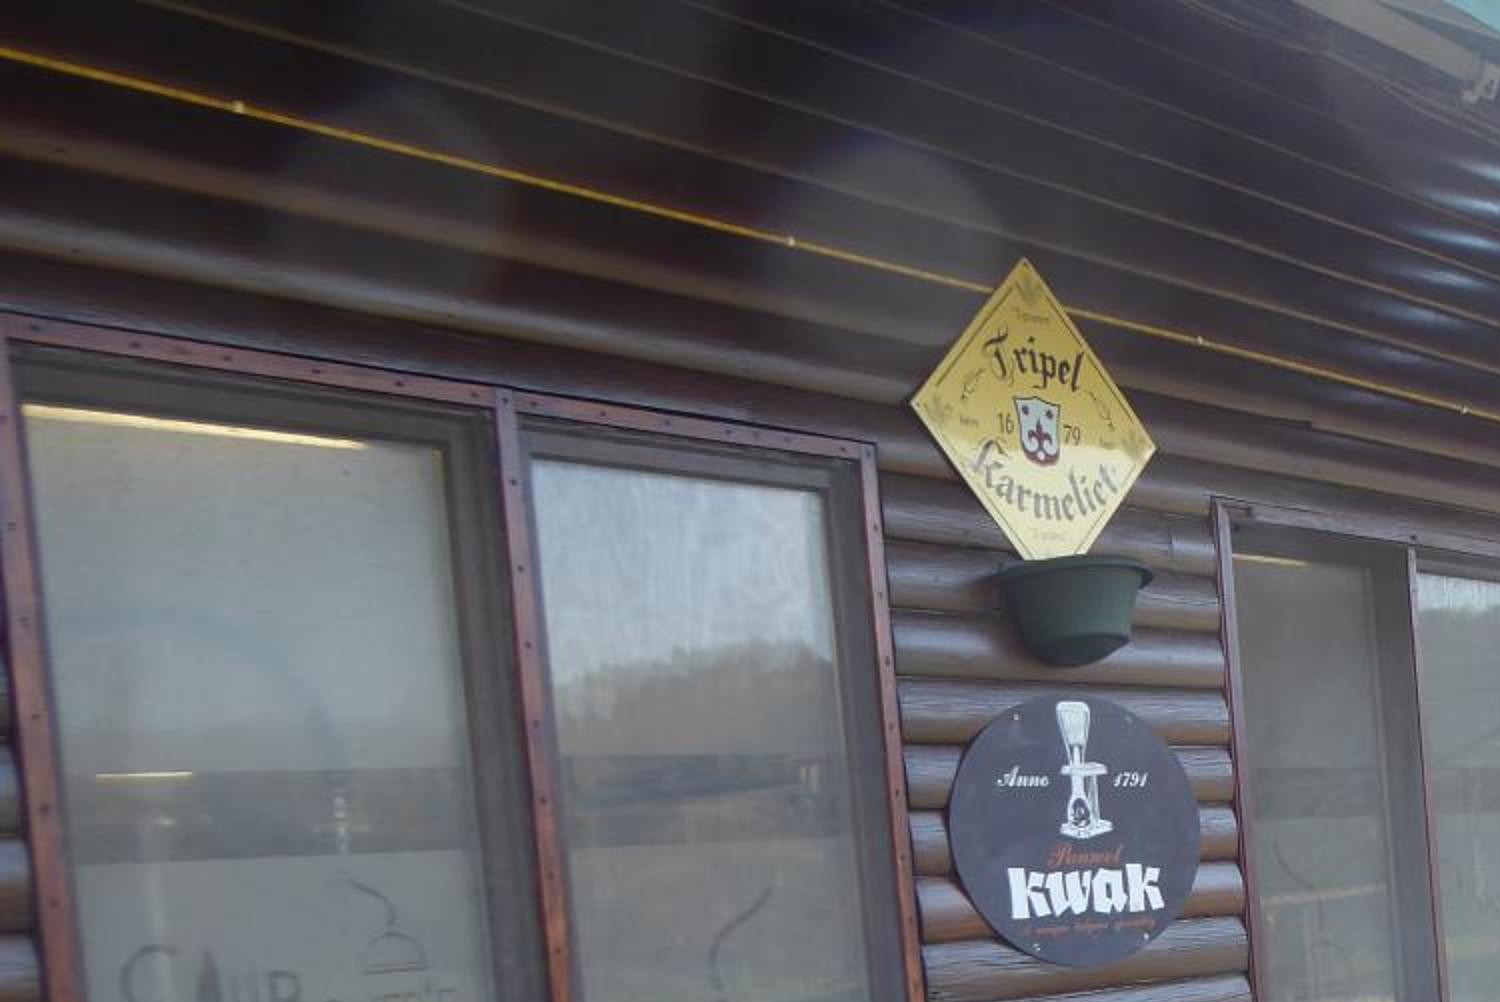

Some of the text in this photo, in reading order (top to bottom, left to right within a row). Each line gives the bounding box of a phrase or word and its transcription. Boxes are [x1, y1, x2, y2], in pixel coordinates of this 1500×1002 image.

[984, 324, 1084, 392] Tripel
[971, 437, 1118, 523] Karmeliet
[997, 765, 1050, 788] Anno
